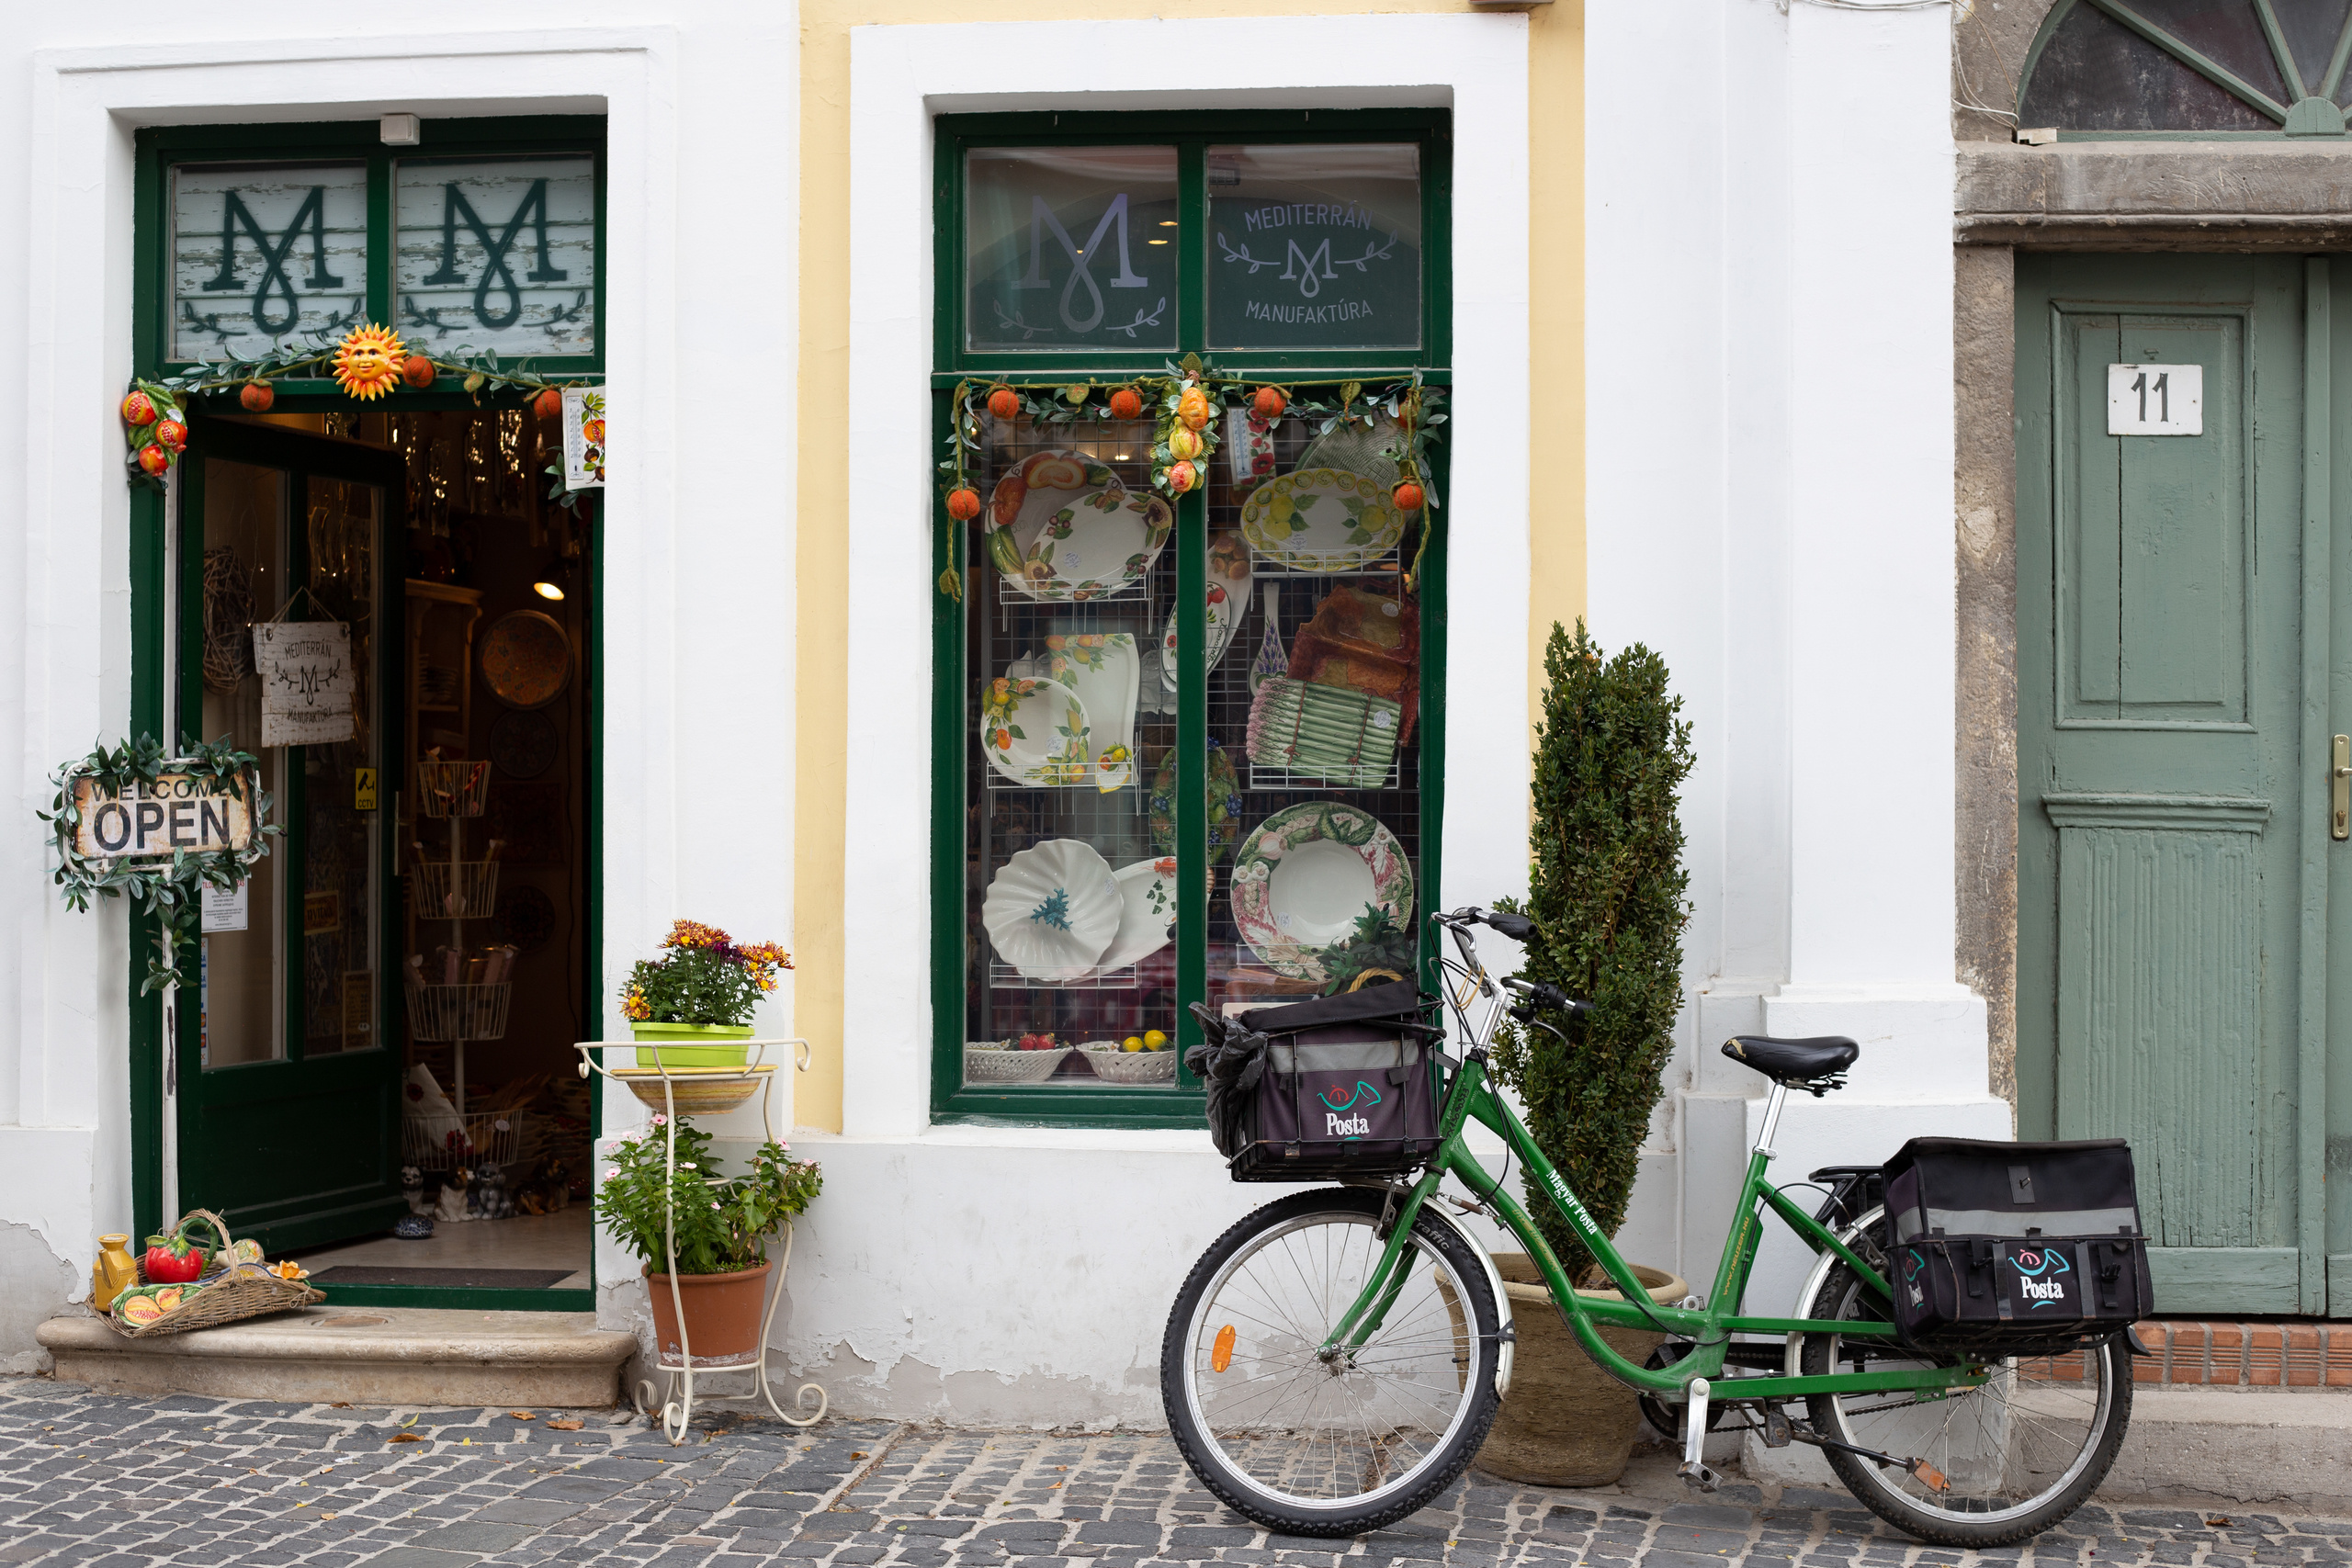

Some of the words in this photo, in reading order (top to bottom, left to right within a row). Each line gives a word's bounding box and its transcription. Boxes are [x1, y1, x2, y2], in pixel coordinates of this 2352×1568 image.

[1244, 200, 1374, 231] MEDITERRÁN
[1245, 298, 1374, 323] MANUFAKTÚRA
[2131, 372, 2169, 423] 11
[284, 637, 332, 660] MEDITERRÁN
[287, 705, 333, 724] MANUFAKTÚRA
[357, 798, 374, 808] CCTV
[94, 798, 231, 852] OPEN
[1325, 1112, 1370, 1135] Posta
[1546, 1168, 1578, 1208] Magyar
[1574, 1206, 1598, 1235] Posta
[2019, 1276, 2064, 1299] Posta
